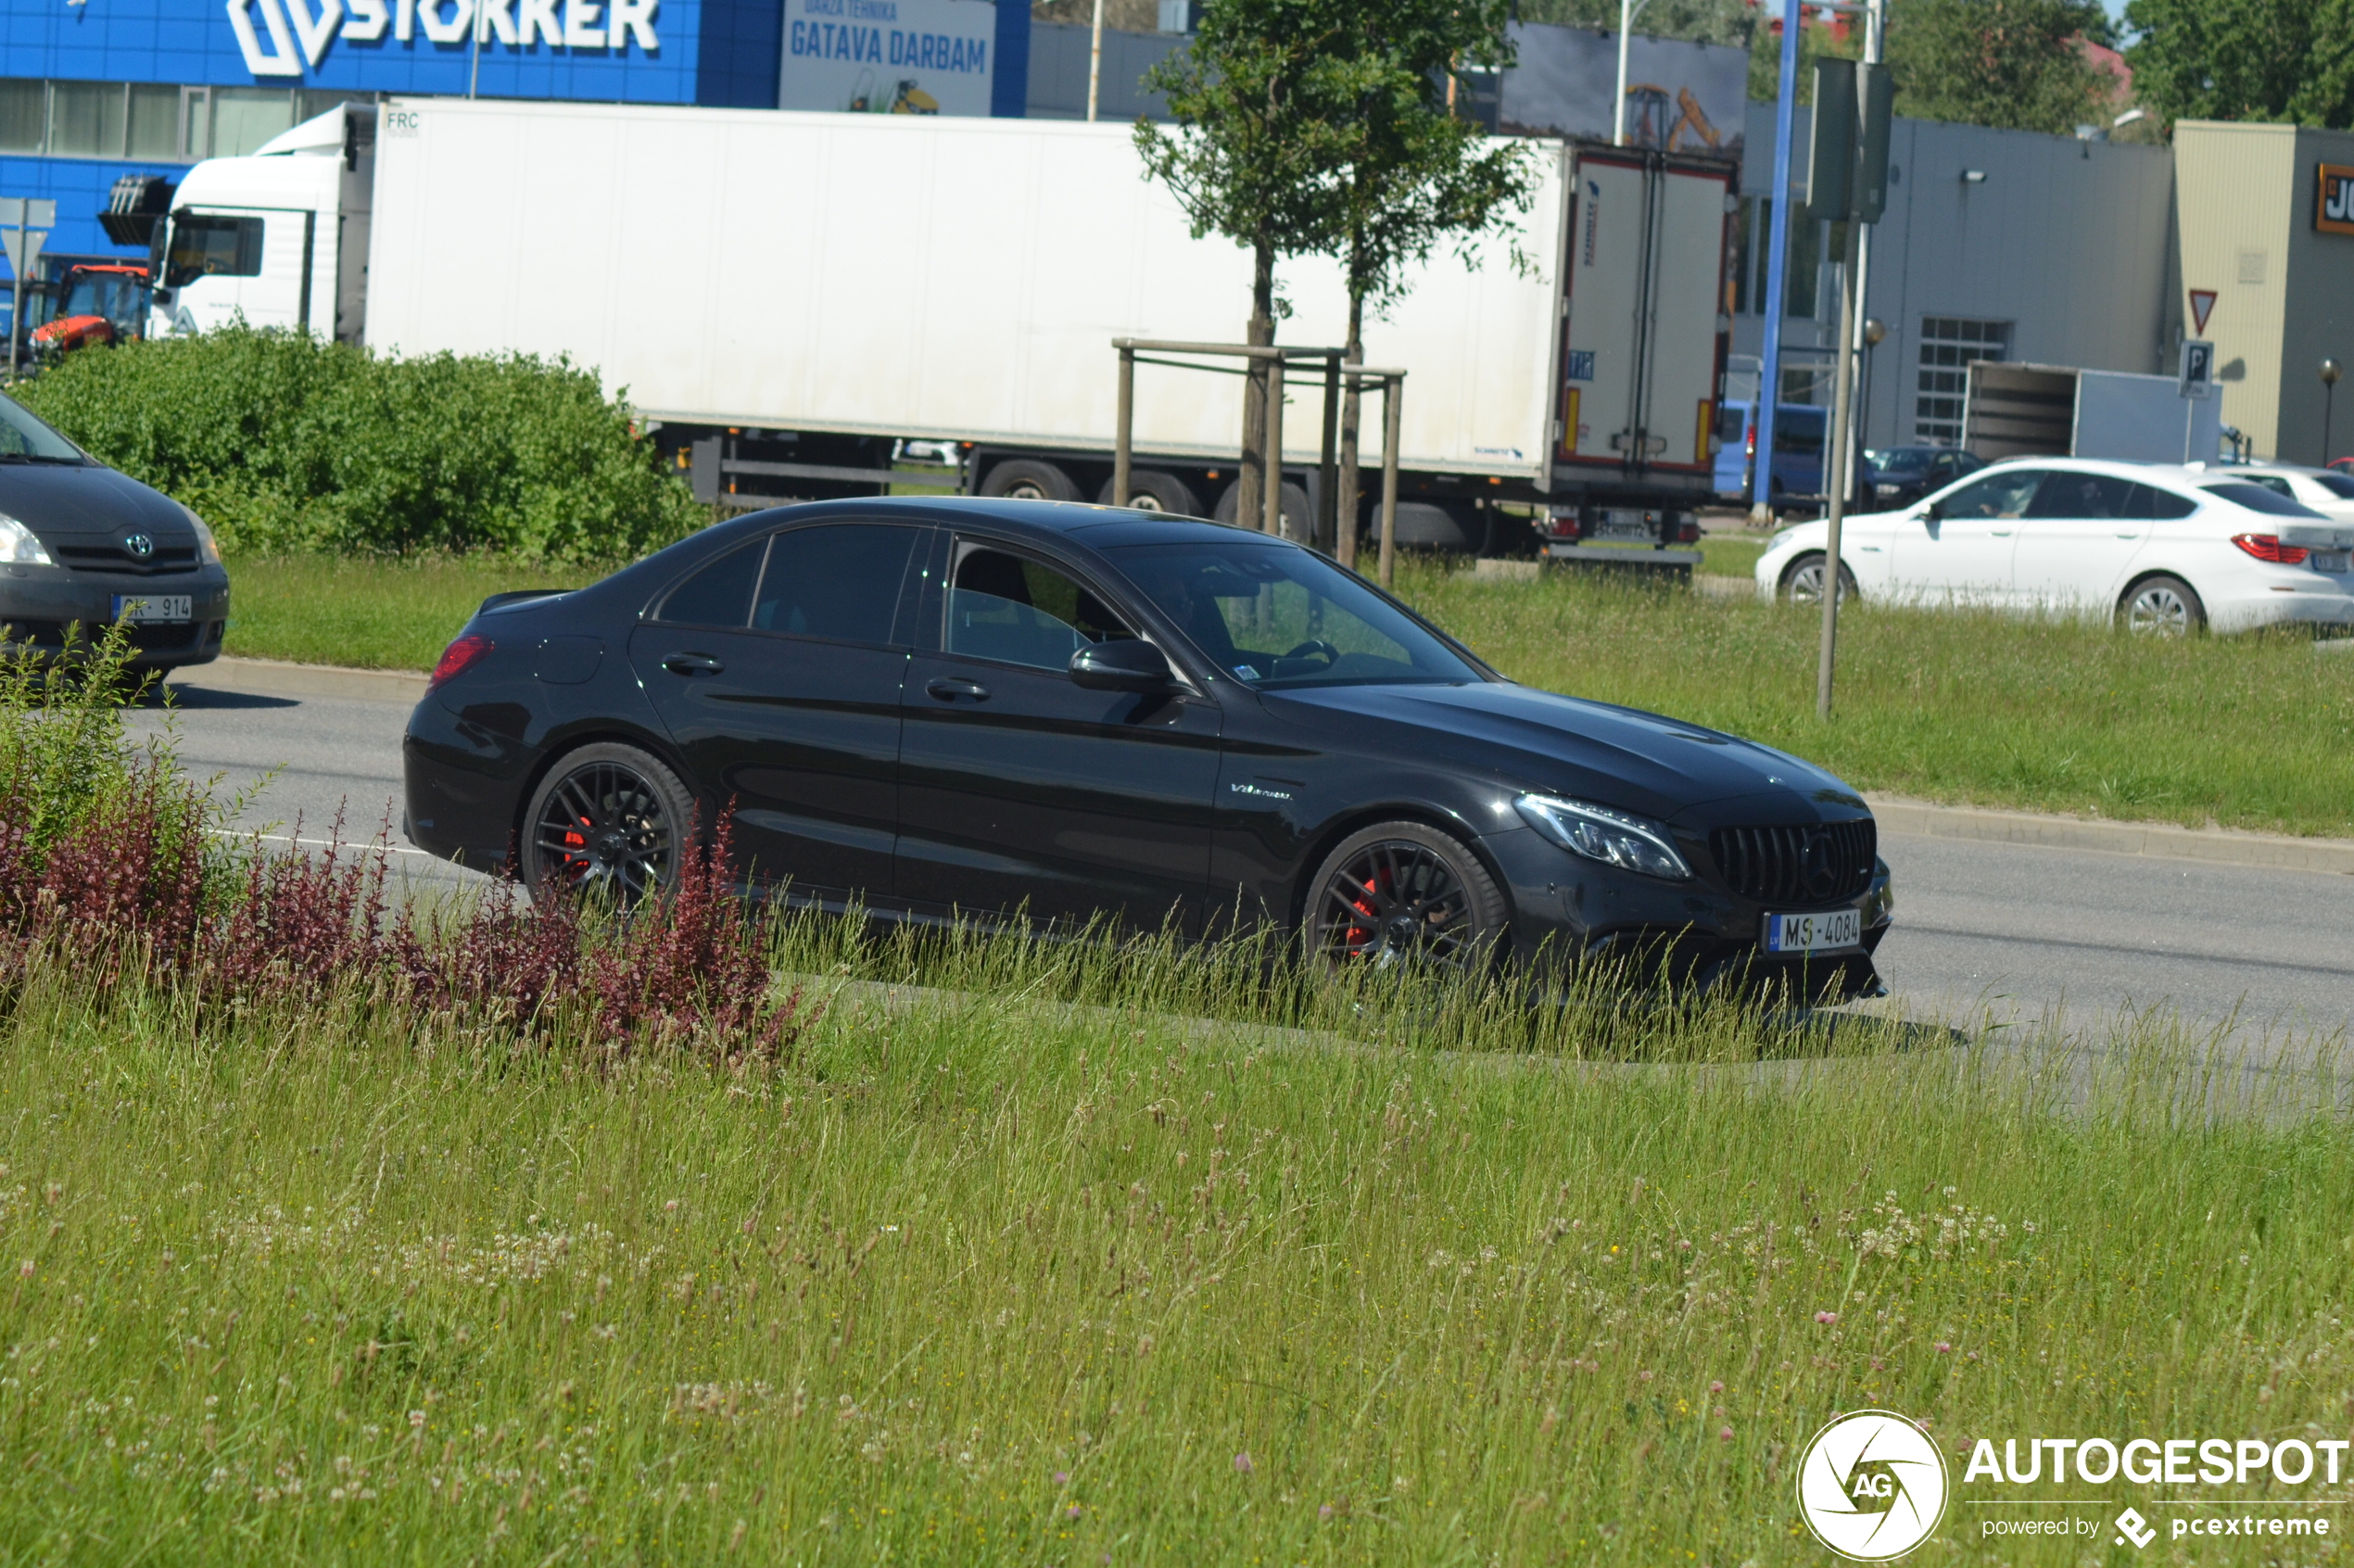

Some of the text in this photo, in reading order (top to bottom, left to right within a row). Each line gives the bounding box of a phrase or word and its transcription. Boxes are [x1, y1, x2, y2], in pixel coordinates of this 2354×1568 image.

[791, 19, 986, 73] GATAVA DARBAM
[386, 112, 419, 129] FRC
[1769, 936, 1779, 945] LV
[1785, 913, 1858, 946] MS-4084
